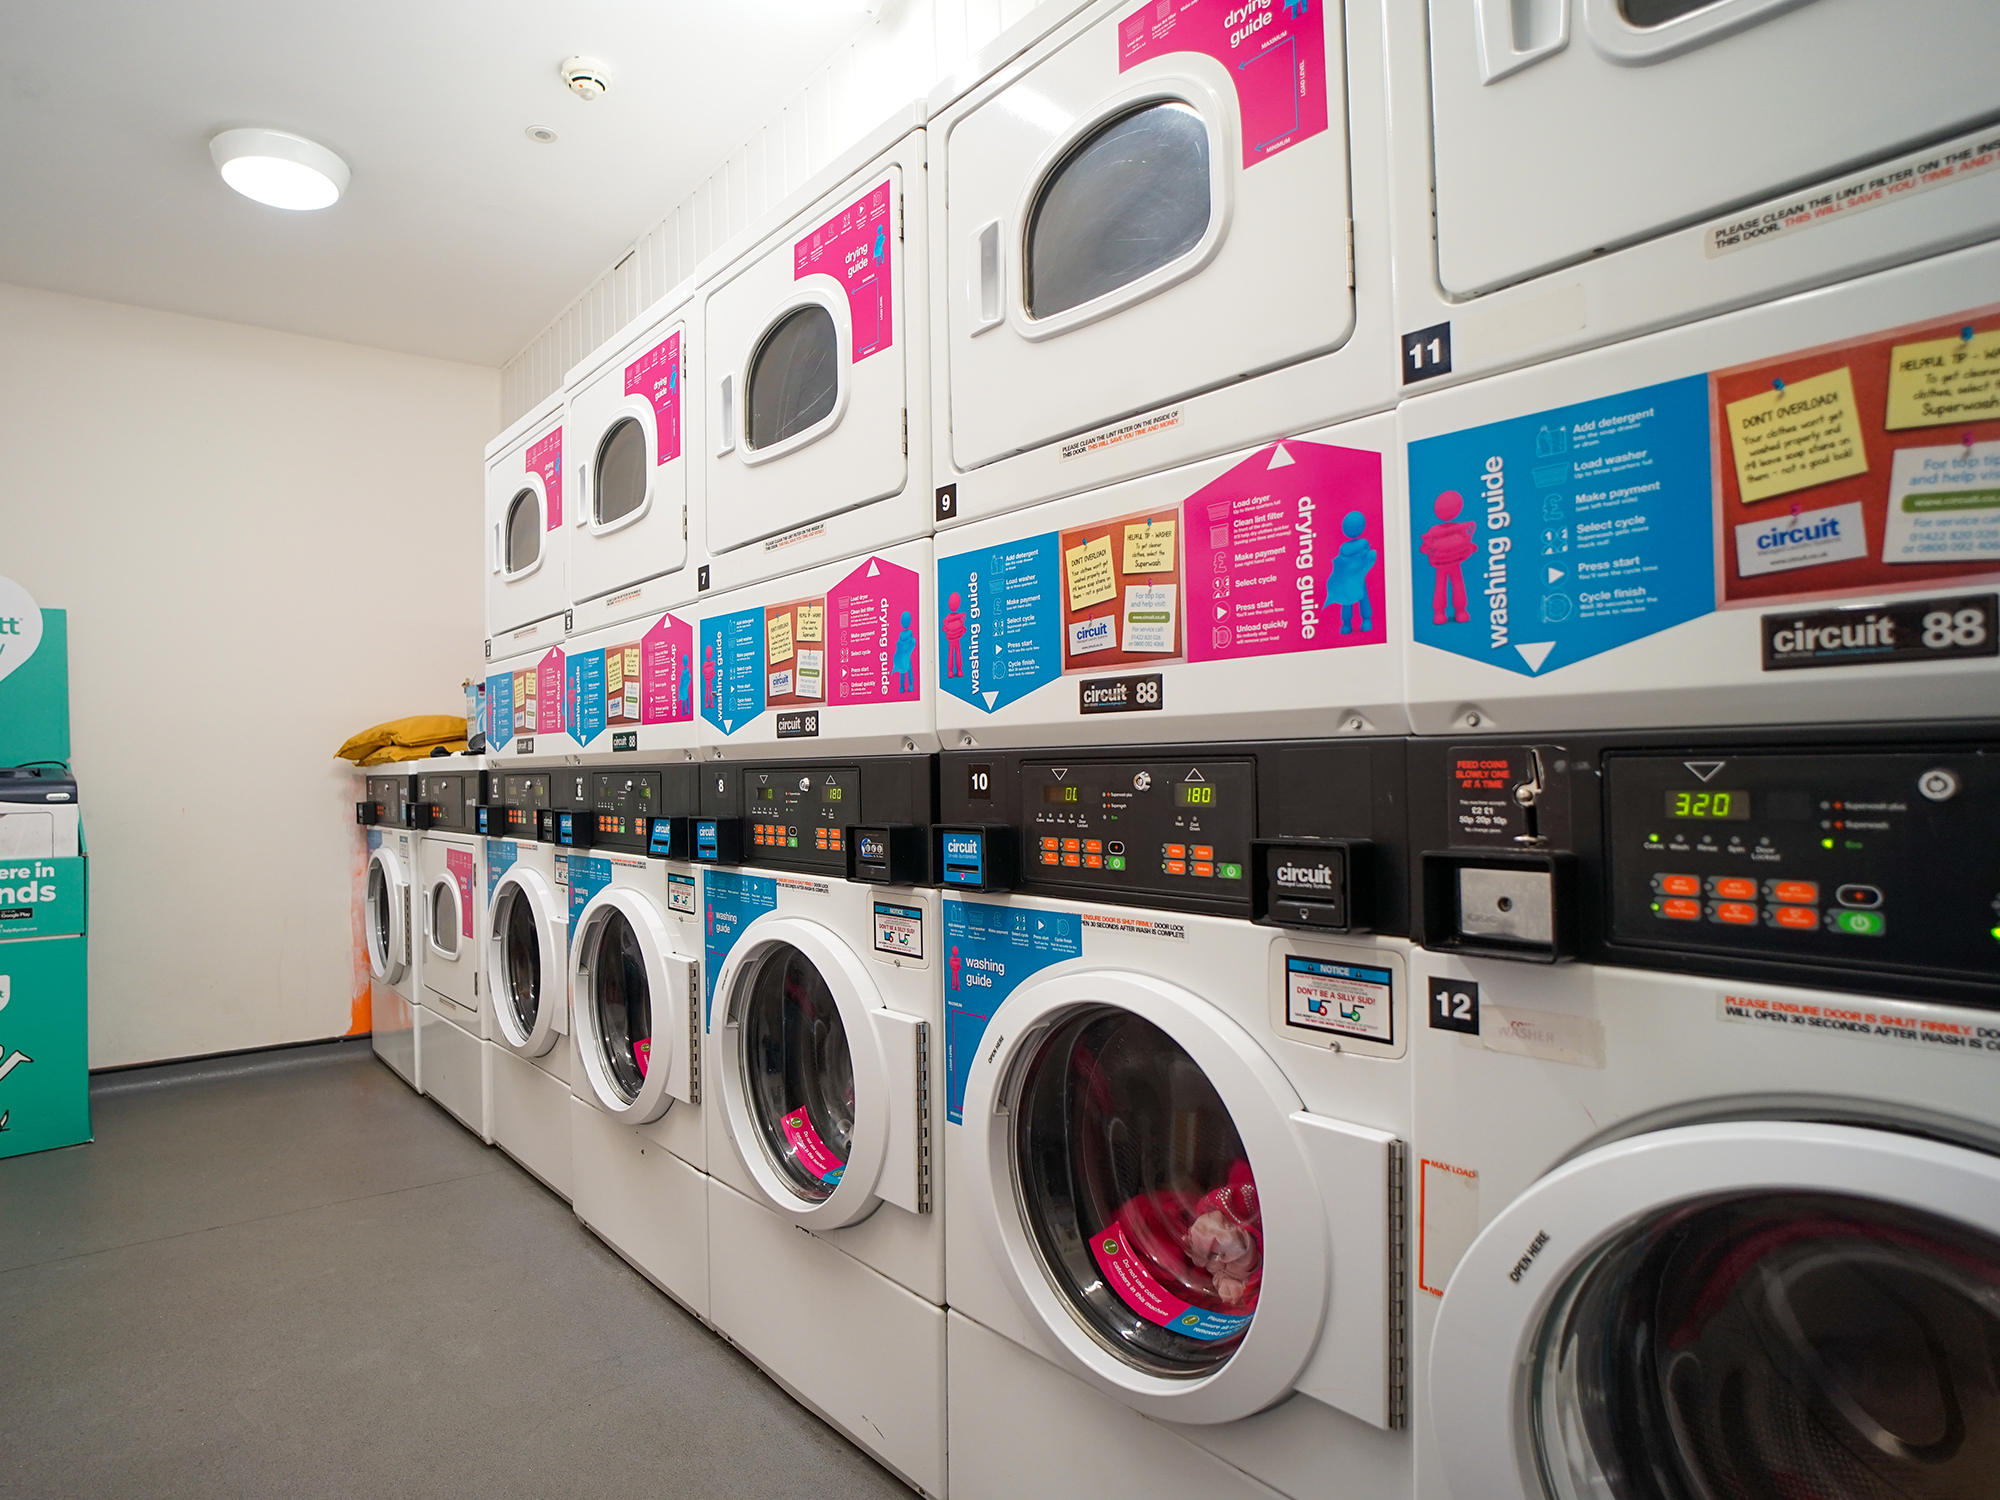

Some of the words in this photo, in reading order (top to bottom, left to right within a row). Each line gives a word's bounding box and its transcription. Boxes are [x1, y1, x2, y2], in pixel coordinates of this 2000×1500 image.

[1230, 10, 1273, 48] guide
[1261, 30, 1288, 49] MAXIMUM
[1715, 218, 1760, 240] PLEASE
[1763, 204, 1805, 225] CLEAN
[1808, 195, 1832, 210] THE
[1836, 183, 1865, 200] LINT
[1869, 168, 1913, 190] FILTER
[1917, 160, 1940, 174] ON
[1943, 149, 1972, 164] THE
[1715, 235, 1740, 249] THIS
[1743, 223, 1780, 240] DOOR.
[1783, 212, 1811, 228] THIS
[1814, 203, 1843, 218] WILL
[1847, 188, 1882, 208] SAVE
[1887, 178, 1917, 194] YOU
[1921, 166, 1954, 184] TIME
[1959, 154, 1993, 172] AND
[845, 243, 868, 265] drying
[848, 258, 868, 278] guide
[1409, 337, 1441, 369] 11
[1742, 410, 1773, 429] DON'T
[1776, 392, 1838, 419] OVERLOAD!
[1573, 420, 1596, 434] Add
[1598, 407, 1654, 428] detergent
[1574, 457, 1602, 471] Load
[1605, 449, 1647, 466] washer
[1233, 499, 1250, 509] Load
[1251, 494, 1270, 505] dryer
[1480, 455, 1511, 530] guide
[1575, 492, 1607, 504] Make
[1609, 480, 1661, 500] payment
[940, 493, 951, 512] 9
[1233, 519, 1253, 528] Clean
[1255, 514, 1266, 524] lint
[1267, 511, 1284, 521] filter
[1576, 520, 1612, 534] Select
[1615, 514, 1646, 529] cycle
[1155, 531, 1172, 539] WASHER
[1295, 496, 1317, 570] drying
[1757, 517, 1840, 550] circuit
[1005, 553, 1016, 562] Add
[1016, 549, 1039, 560] detergent
[1234, 553, 1254, 562] Make
[1255, 546, 1286, 559] payment
[1134, 559, 1161, 569] Superwash
[1578, 561, 1610, 573] Press
[1612, 555, 1640, 569] start
[700, 572, 707, 585] 7
[1006, 577, 1017, 585] Load
[1018, 574, 1036, 583] washer
[1235, 577, 1257, 587] Select
[1258, 575, 1277, 585] cycle
[968, 571, 981, 619] guide
[1020, 594, 1041, 605] payment
[1145, 592, 1154, 600] top
[1155, 592, 1165, 600] tips
[1484, 536, 1511, 649] washing
[1579, 591, 1611, 604] Cycle
[1614, 586, 1646, 599] finish
[1142, 600, 1153, 608] help
[1236, 603, 1256, 612] Press
[1257, 600, 1273, 609] start
[1296, 575, 1319, 640] guide
[879, 598, 889, 648] drying
[1007, 616, 1022, 624] Select
[1022, 614, 1035, 623] cycle
[1236, 622, 1261, 632] Unload
[1262, 620, 1288, 630] quickly
[1077, 623, 1107, 640] circuit
[1773, 613, 1896, 653] circuit
[1922, 608, 1985, 649] 88
[716, 631, 724, 666] guide
[1007, 641, 1021, 649] Press
[1021, 639, 1033, 647] start
[969, 624, 981, 695] washing
[1022, 658, 1035, 666] finish
[880, 651, 889, 695] guide
[1084, 683, 1127, 703] circuit
[1136, 681, 1158, 704] 88
[778, 713, 801, 731] circuit
[805, 716, 816, 732] 88
[1457, 760, 1479, 769] FEED
[1480, 760, 1508, 769] COINS
[972, 773, 988, 790] 10
[1455, 770, 1489, 778] SLOWLY
[1491, 770, 1510, 779] ONE
[1462, 780, 1472, 788] AT
[1474, 780, 1481, 788] A
[1482, 780, 1504, 788] TIME
[717, 779, 725, 793] 8
[1187, 787, 1211, 804] 180
[1471, 806, 1482, 815] £2
[1484, 806, 1494, 815] £1
[1675, 792, 1731, 817] 320
[1459, 815, 1474, 825] 50p
[1475, 815, 1491, 826] 20p
[1492, 816, 1508, 826] 10p
[948, 839, 978, 854] circuit
[35, 861, 55, 878] in
[1276, 862, 1332, 884] circuit
[965, 956, 1006, 976] washing
[1320, 964, 1350, 977] NOTICE
[966, 973, 992, 988] guide
[1297, 986, 1318, 997] DON'T
[1320, 989, 1328, 998] BE
[1337, 992, 1356, 1002] SILLY
[1357, 995, 1376, 1005] SUD!
[1436, 991, 1471, 1021] 12
[1725, 995, 1769, 1009] PLEASE
[1772, 1001, 1819, 1016] ENSURE
[1823, 1007, 1862, 1022] DOOR
[1865, 1013, 1877, 1023] IS
[1880, 1015, 1917, 1028] SHUT
[1498, 1026, 1554, 1043] WASHER
[1725, 1005, 1751, 1017] WILL
[1754, 1010, 1788, 1024] OPEN
[1790, 1014, 1805, 1024] 30
[1807, 1018, 1870, 1034] SECONDS
[1874, 1025, 1918, 1040] AFTER
[1920, 1031, 1966, 1046] WASH
[1969, 1038, 1982, 1048] IS
[1430, 1159, 1451, 1173] MAX
[1452, 1165, 1476, 1179] LOAD
[1509, 1254, 1532, 1285] OPEN
[1528, 1229, 1551, 1258] HERE
[1113, 1261, 1131, 1286] catchers
[1129, 1285, 1137, 1293] in
[1135, 1290, 1146, 1303] this
[1144, 1301, 1169, 1317] machine
[1122, 1258, 1130, 1268] Do
[1128, 1268, 1137, 1280] not
[1135, 1279, 1145, 1290] use
[1144, 1288, 1162, 1304] colour
